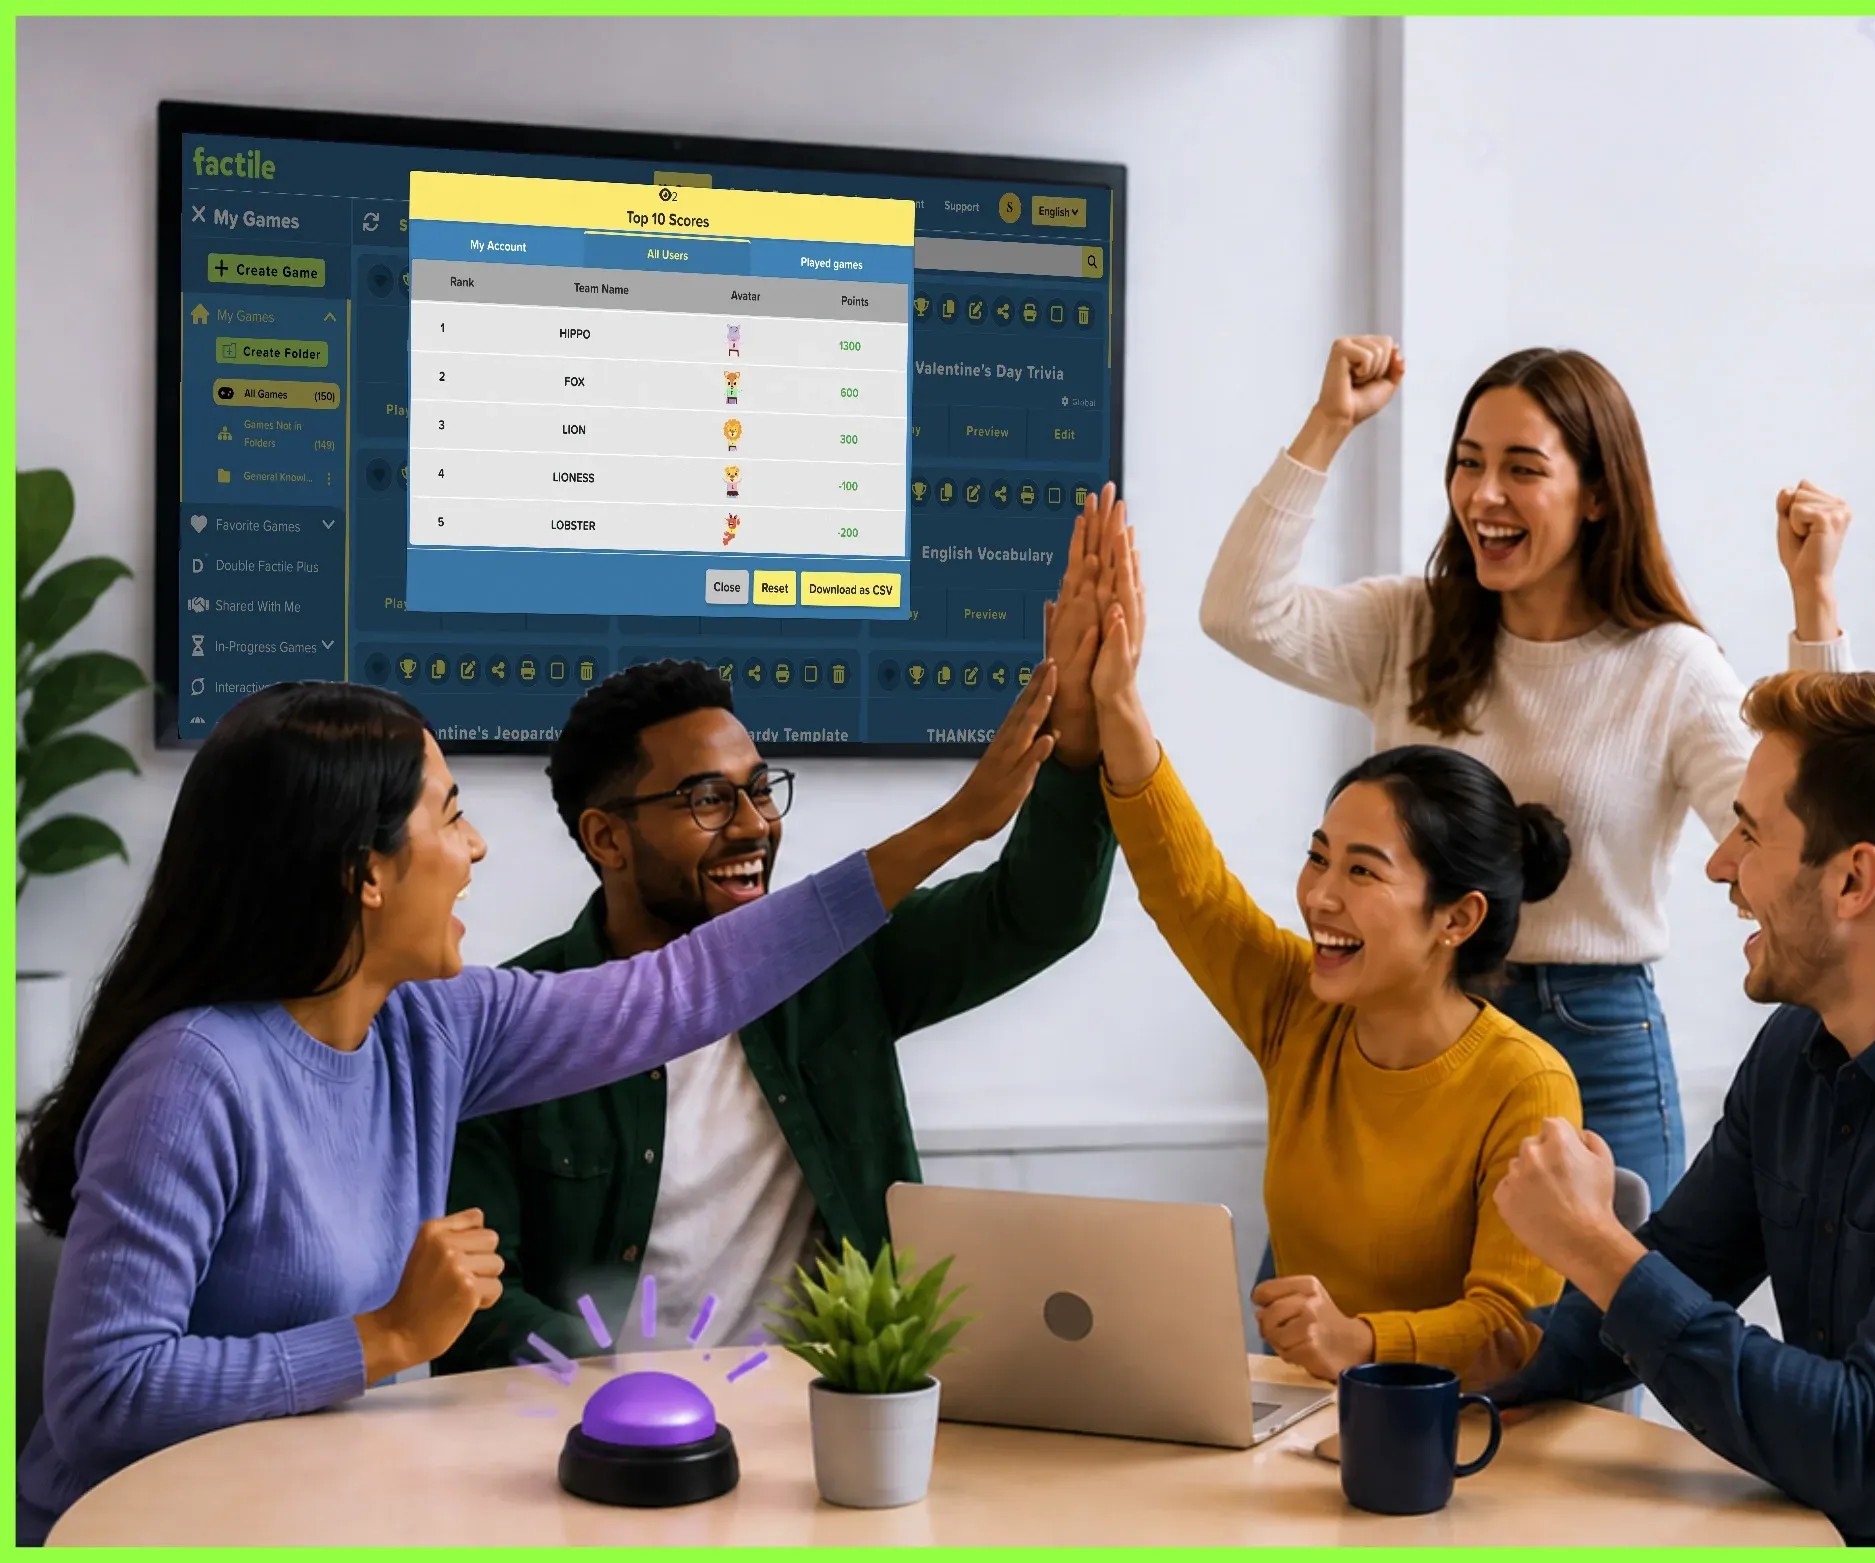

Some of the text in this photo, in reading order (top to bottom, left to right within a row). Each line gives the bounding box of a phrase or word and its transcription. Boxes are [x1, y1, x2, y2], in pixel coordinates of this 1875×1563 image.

[193, 147, 276, 180] factile
[672, 191, 678, 202] 2
[944, 200, 980, 212] Support
[1039, 206, 1070, 218] English
[213, 209, 300, 230] My Games
[627, 211, 710, 228] Top 10 Scores
[470, 240, 527, 253] My Account
[647, 249, 689, 261] All Users
[801, 257, 863, 270] Played games
[236, 263, 318, 281] Create Game
[450, 277, 869, 307] Rank Team Name Avatar Points
[217, 310, 275, 325] My Games
[559, 328, 591, 339] HIPPO
[839, 341, 861, 351] 1300
[243, 346, 321, 361] Create Folder
[915, 361, 1064, 382] Valentine's Day Trivia
[438, 371, 859, 398] 2 FOX 600
[244, 388, 336, 403] All Games (150)
[244, 420, 302, 431] Games Not in
[438, 420, 858, 445] 3 LION 300
[966, 426, 1009, 438] Preview
[1054, 429, 1075, 440] Edit
[244, 438, 335, 451] Folders (149)
[244, 472, 278, 481] General
[438, 469, 859, 491] 4 LIONESS -100
[216, 519, 301, 533] Favorite Games
[438, 517, 859, 538] 5 LOBSTER -200
[922, 545, 1053, 565] English Vocabulary
[216, 560, 319, 573] Double Factile Plus
[714, 582, 741, 593] Close
[761, 583, 789, 594] Reset
[809, 584, 893, 596] Download as CSV
[215, 600, 301, 613] Shared With Me
[964, 608, 1007, 620] Preview
[215, 641, 317, 655] In-Progress Games
[436, 724, 489, 740] ntine's
[783, 728, 849, 742] Template
[926, 728, 996, 743] THANKSG
